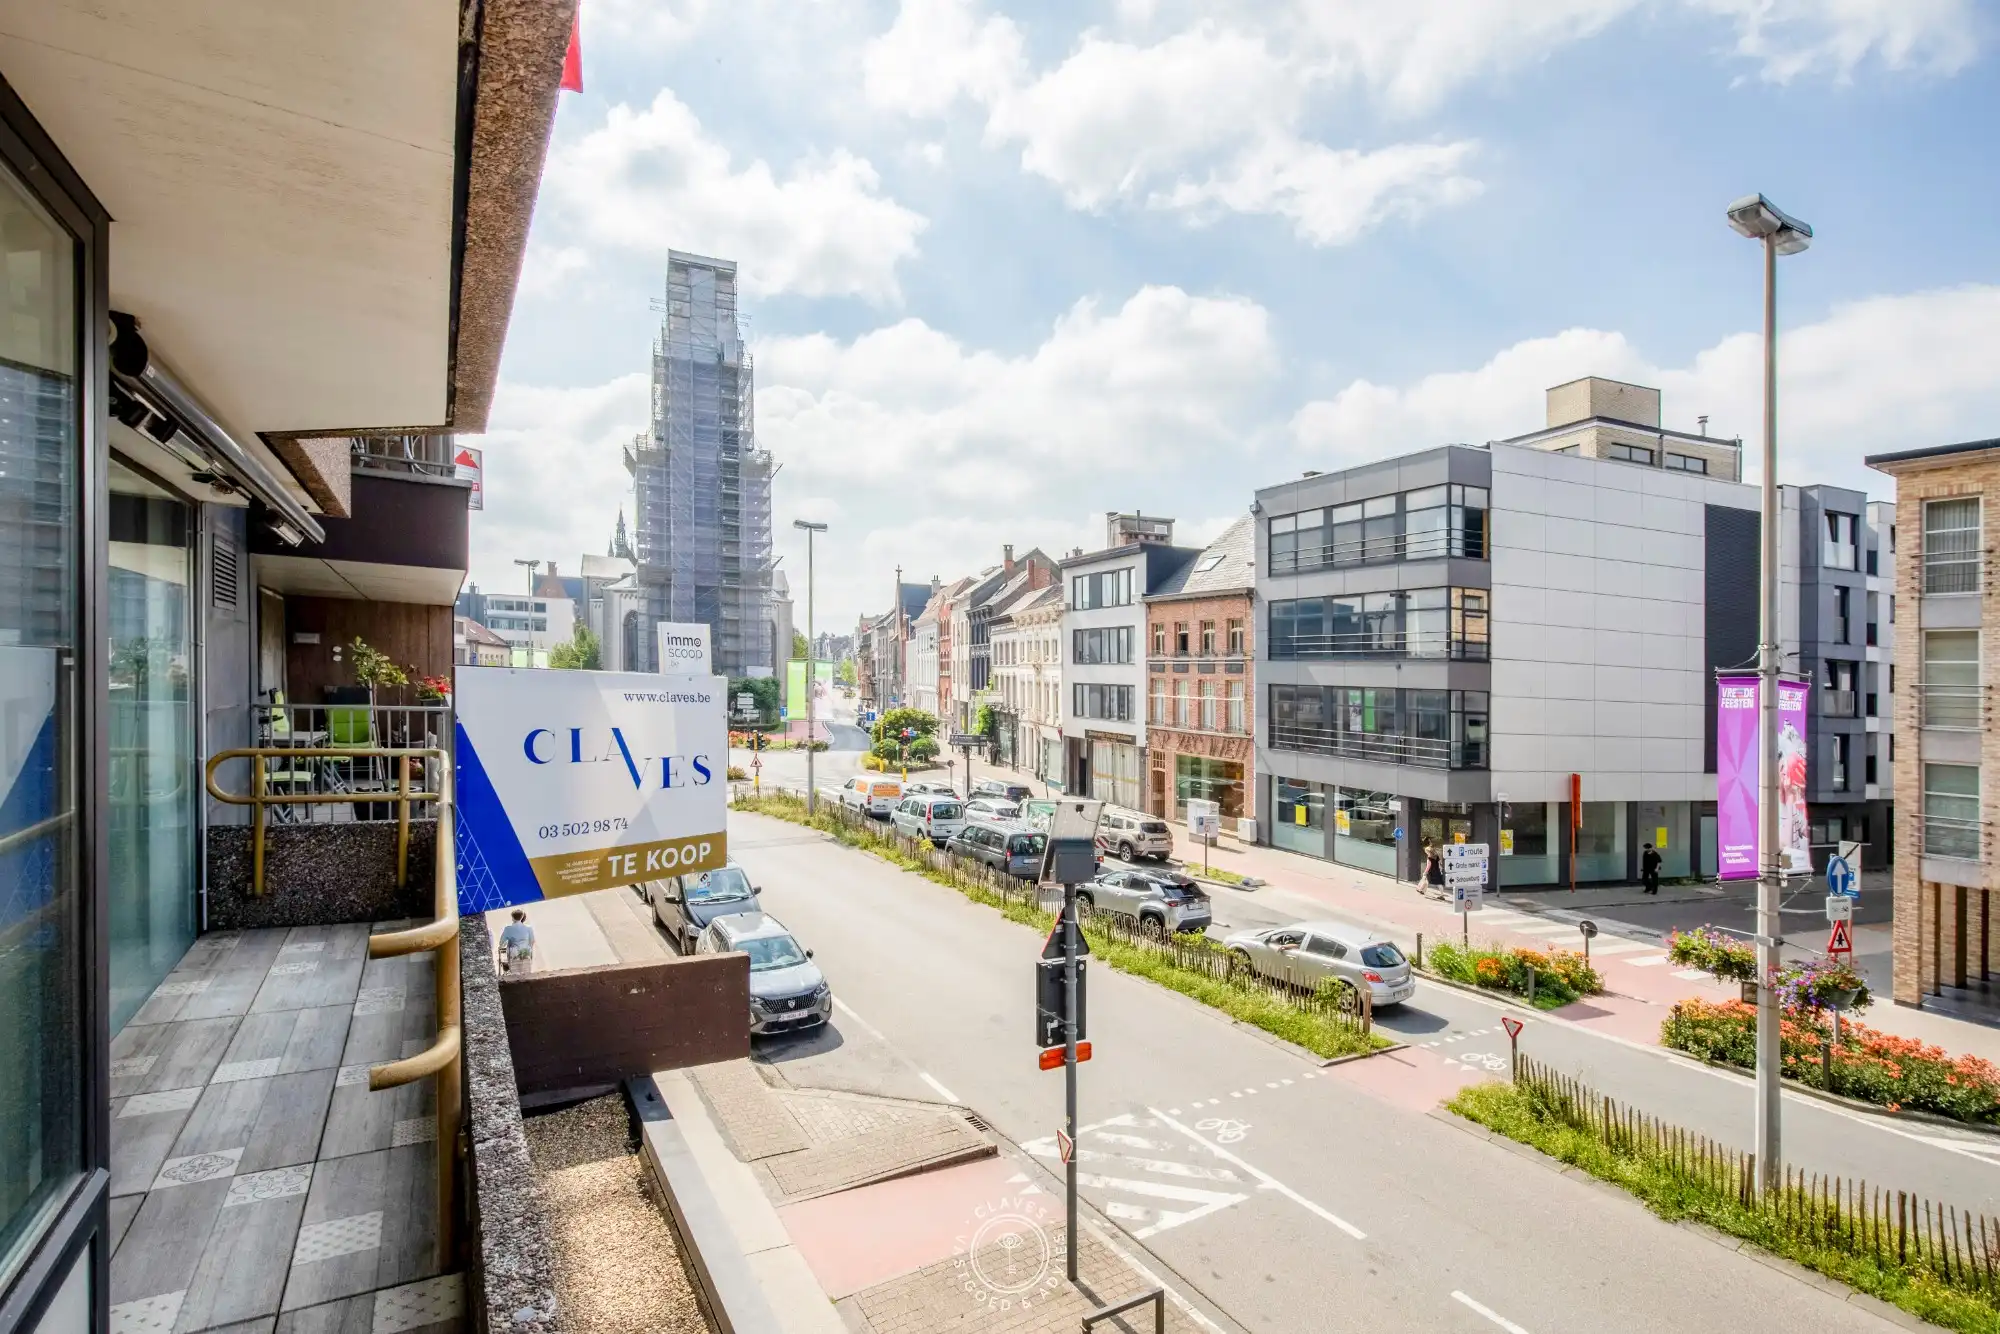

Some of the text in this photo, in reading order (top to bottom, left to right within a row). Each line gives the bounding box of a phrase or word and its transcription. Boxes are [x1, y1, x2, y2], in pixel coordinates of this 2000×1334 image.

[667, 632, 702, 647] immo
[624, 691, 711, 703] www.claves.be
[1721, 698, 1755, 709] FEESTEN
[523, 727, 711, 790] CLAVES
[538, 817, 629, 839] 03 502 98 74
[607, 852, 638, 878] TE
[646, 842, 711, 872] KOOP
